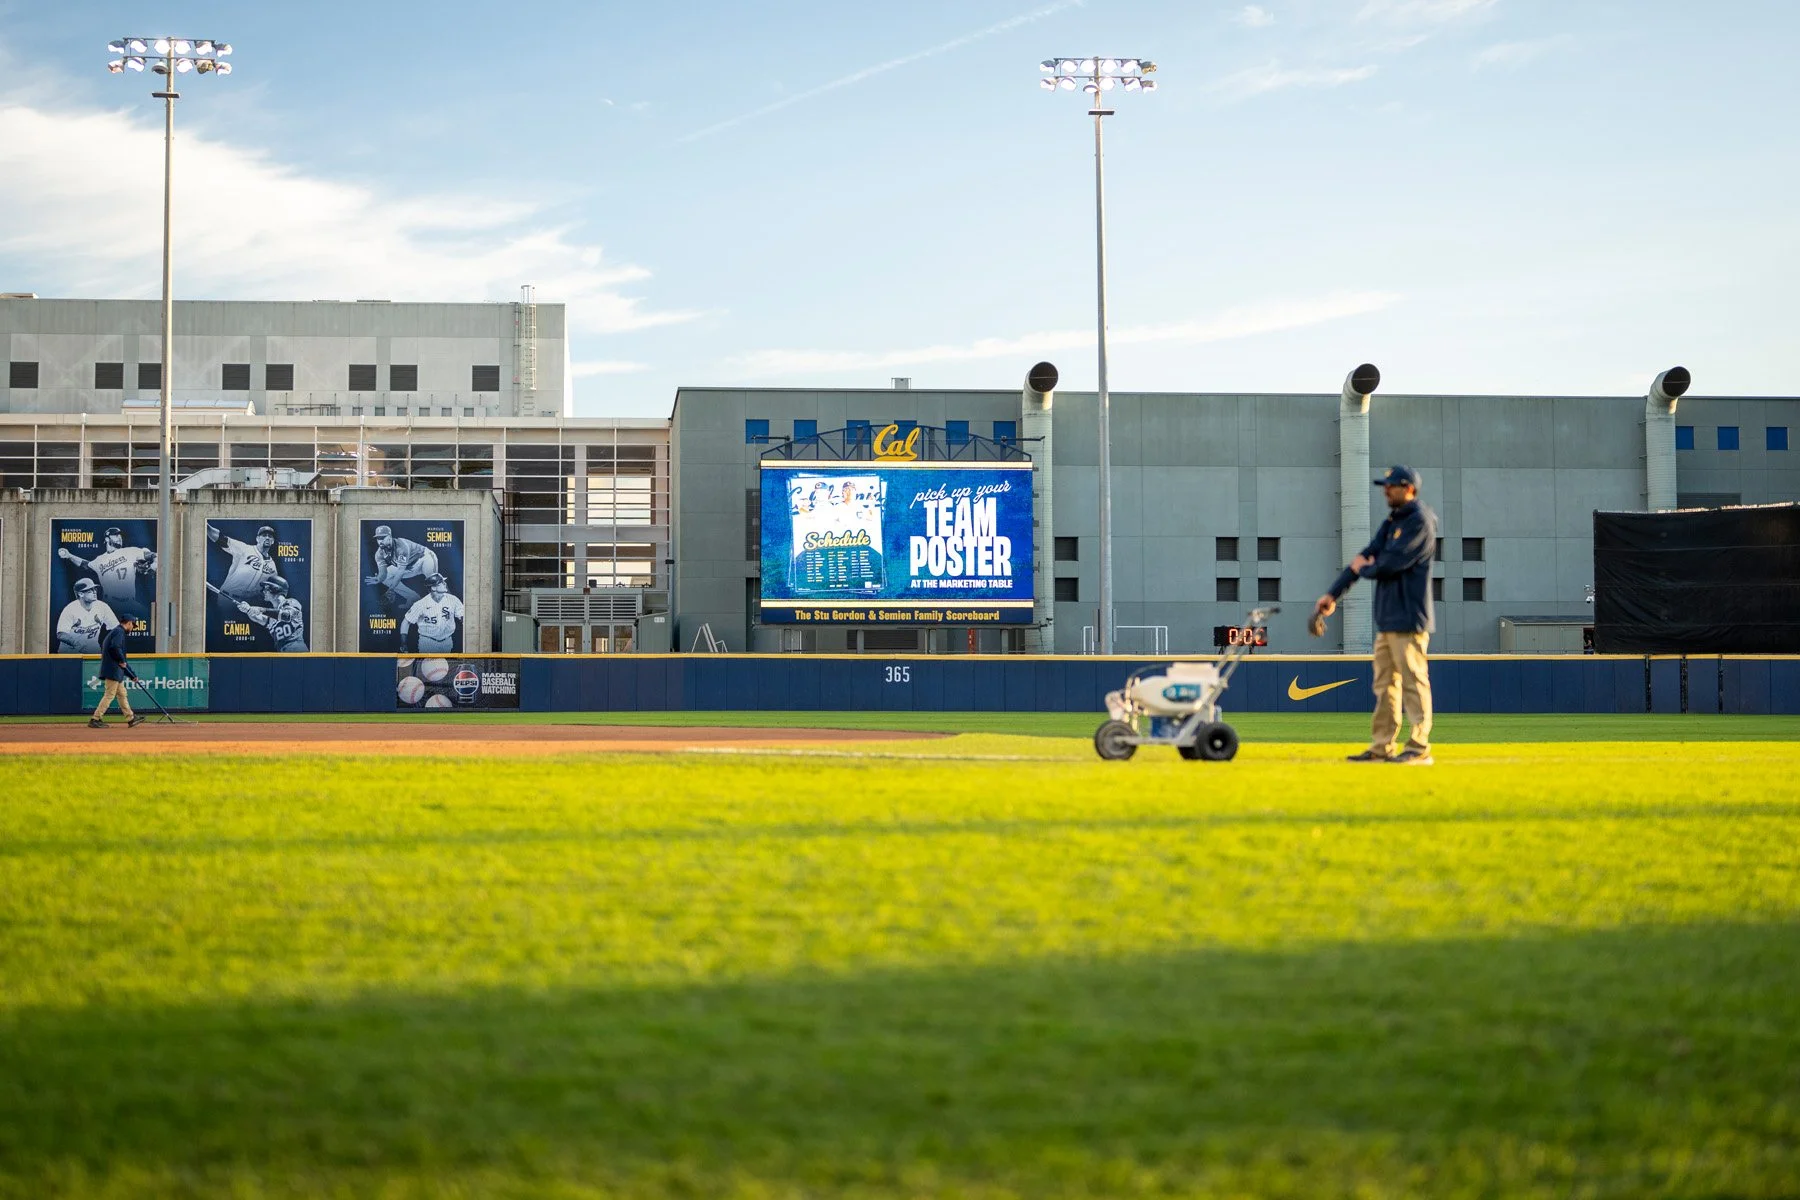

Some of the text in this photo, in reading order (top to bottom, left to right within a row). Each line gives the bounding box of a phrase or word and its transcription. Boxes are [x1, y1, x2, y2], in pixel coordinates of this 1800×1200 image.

[873, 424, 920, 461] Cal
[910, 483, 948, 509] pick
[951, 487, 973, 505] up
[973, 480, 1012, 504] your
[923, 497, 997, 537] TEAM
[61, 532, 94, 543] MORROW
[426, 531, 452, 542] SEMIEN
[803, 529, 871, 551] Schedule
[278, 545, 299, 557] ROSS
[909, 535, 1012, 577] POSTER
[116, 567, 127, 580] 17
[911, 580, 1013, 588] AT THE MARKETING TABLE
[795, 610, 1000, 622] The Stu Gordon & Semien Family Scoreboard
[133, 620, 147, 631] AIG
[224, 623, 250, 635] CANHA
[369, 618, 396, 629] VAUGHN
[274, 623, 293, 640] 20
[885, 666, 910, 682] 365
[123, 676, 204, 690] tter Health
[481, 679, 516, 687] BASEBALL
[481, 686, 516, 695] WATCHING
